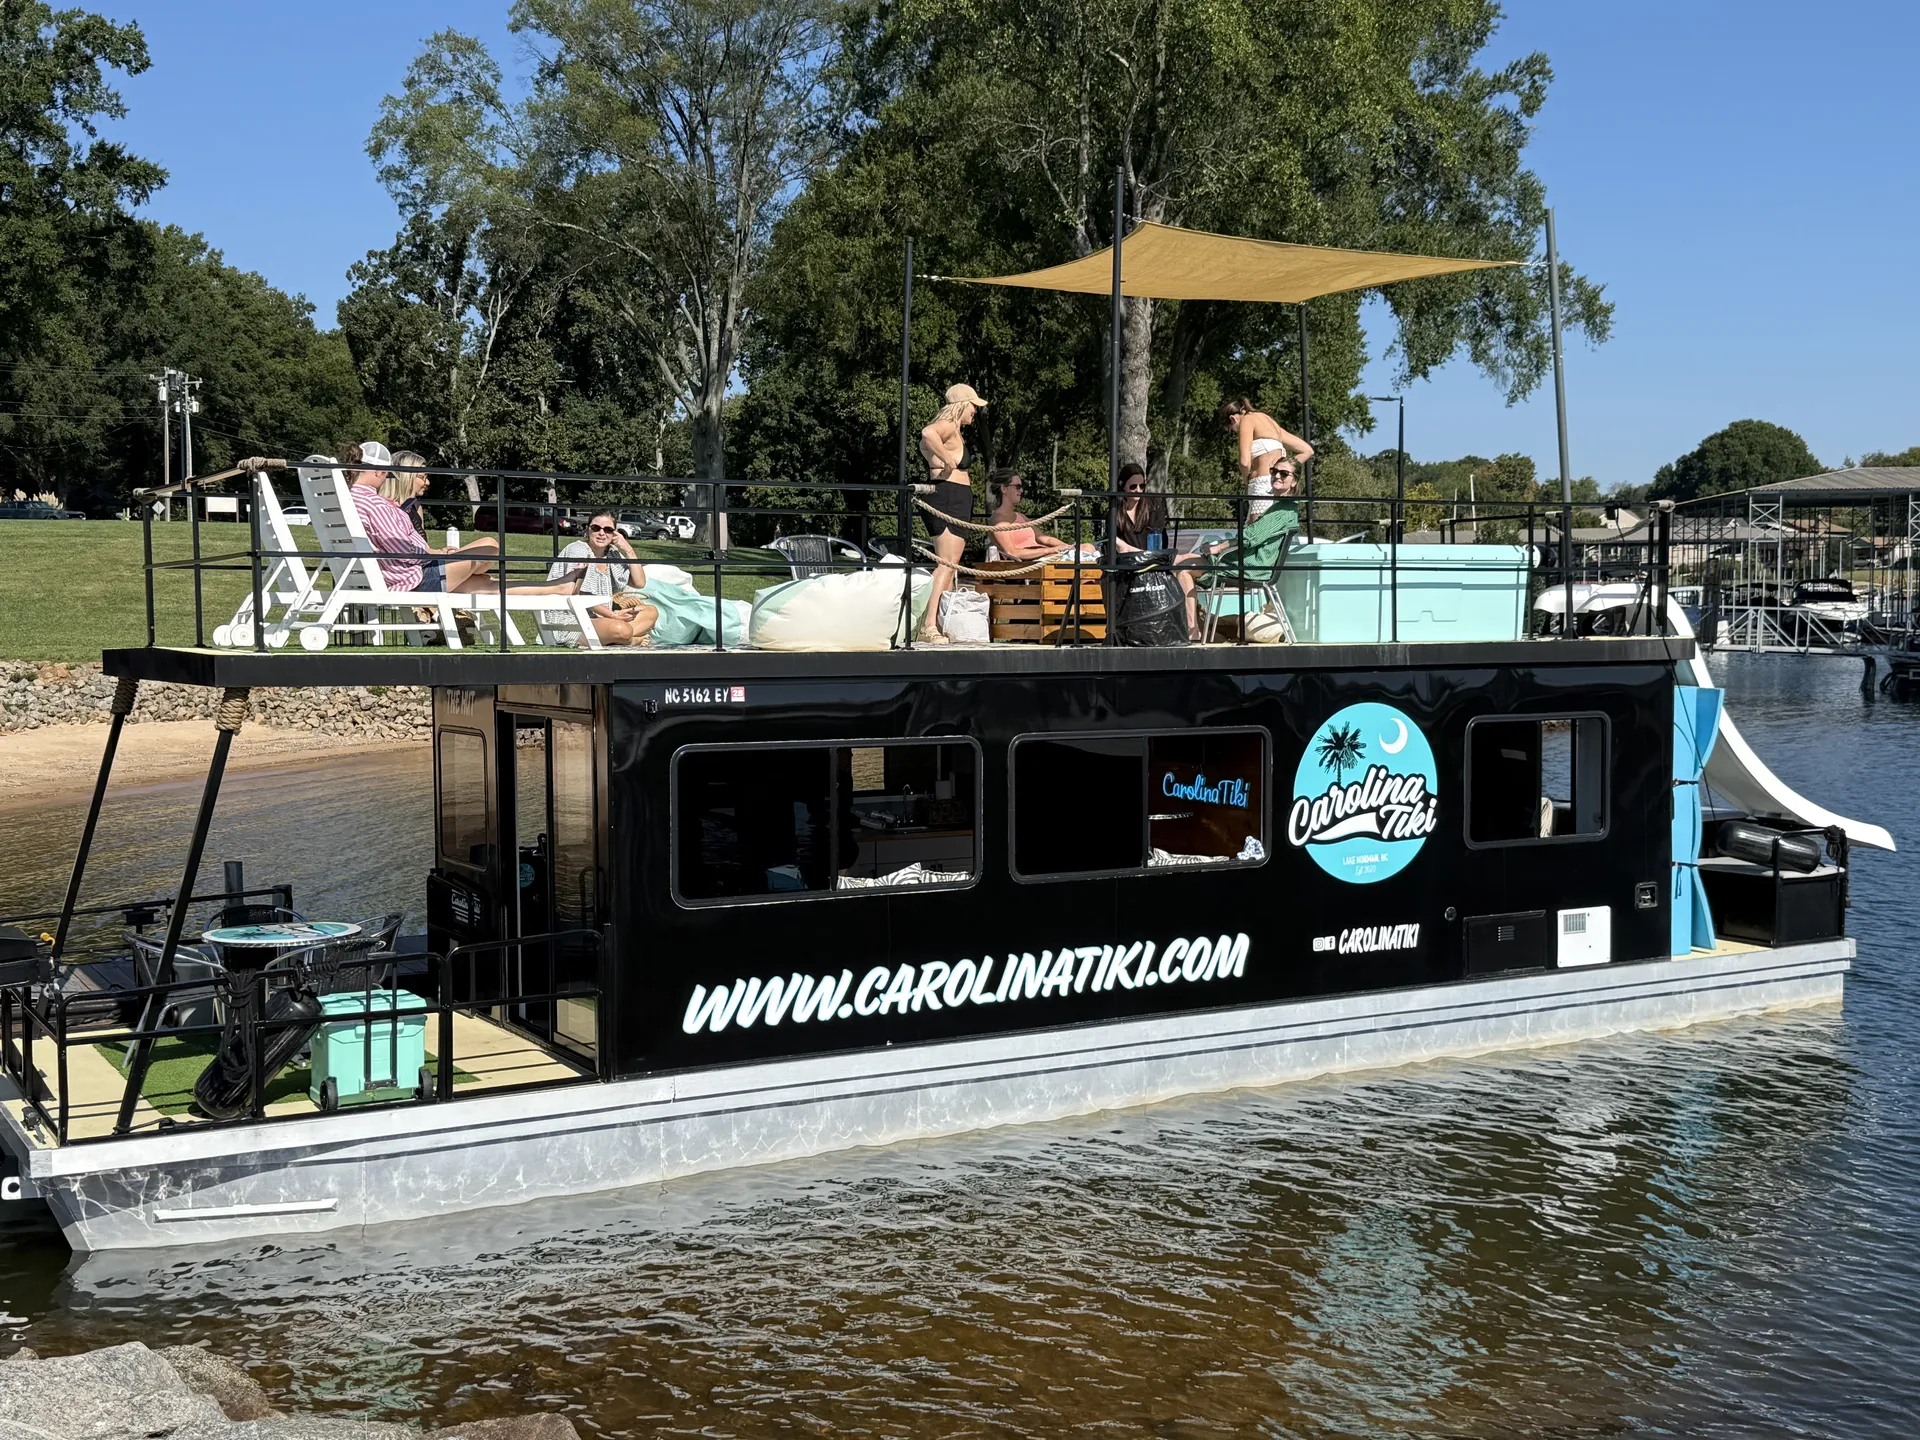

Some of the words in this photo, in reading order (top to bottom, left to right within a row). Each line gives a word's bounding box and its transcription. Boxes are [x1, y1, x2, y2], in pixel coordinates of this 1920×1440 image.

[447, 689, 460, 715] THE
[461, 690, 476, 716] HUT
[664, 688, 680, 704] NC
[682, 688, 711, 703] 5162
[714, 688, 729, 703] EY
[1288, 767, 1425, 847] Carolina
[1380, 798, 1438, 840] Tiki
[1342, 855, 1356, 865] LAKE
[1338, 923, 1420, 954] CAROLINATIKI
[682, 932, 1250, 1034] WWW.CAROLINATIKI.COM
